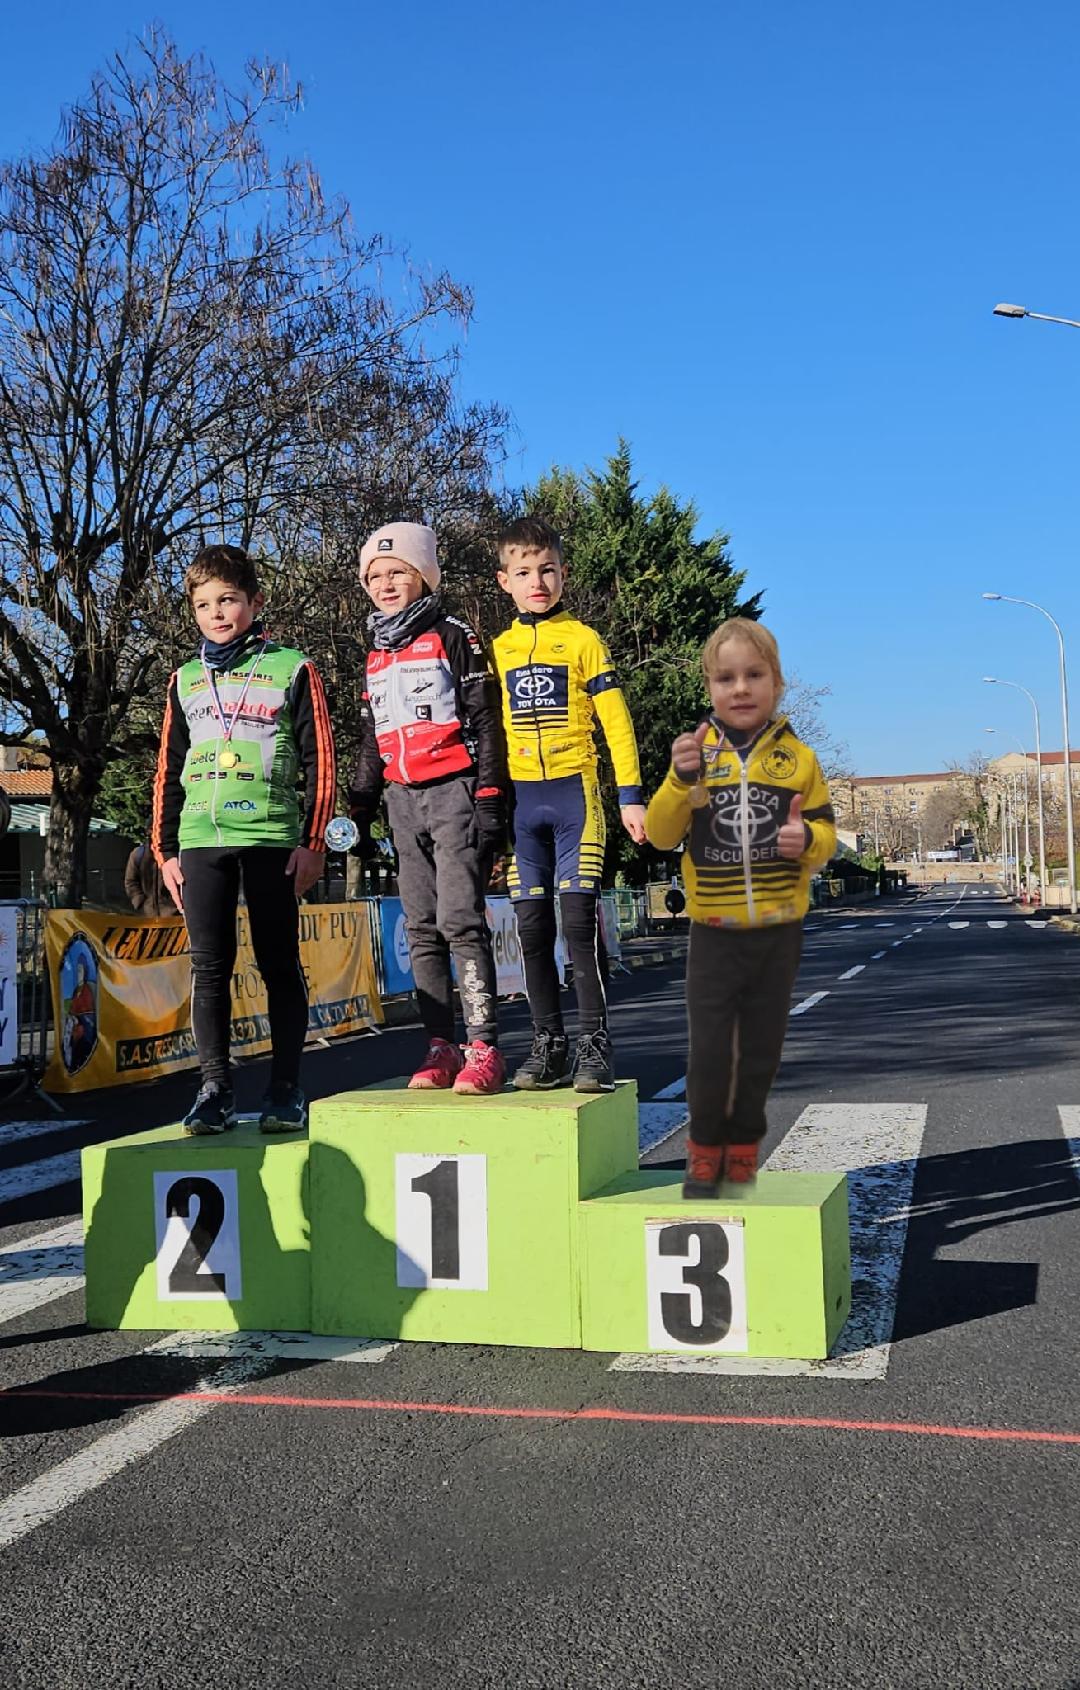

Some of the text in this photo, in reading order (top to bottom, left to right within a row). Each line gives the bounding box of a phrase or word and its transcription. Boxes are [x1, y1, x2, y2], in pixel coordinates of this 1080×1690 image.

[517, 698, 556, 708] TOYOTA
[224, 800, 257, 810] ATOL
[708, 787, 779, 810] TOYOTA
[704, 846, 780, 862] ESCUDER
[330, 911, 357, 938] PUY
[410, 1160, 459, 1280] 1
[166, 1177, 225, 1293] 2
[659, 1223, 732, 1345] 3
